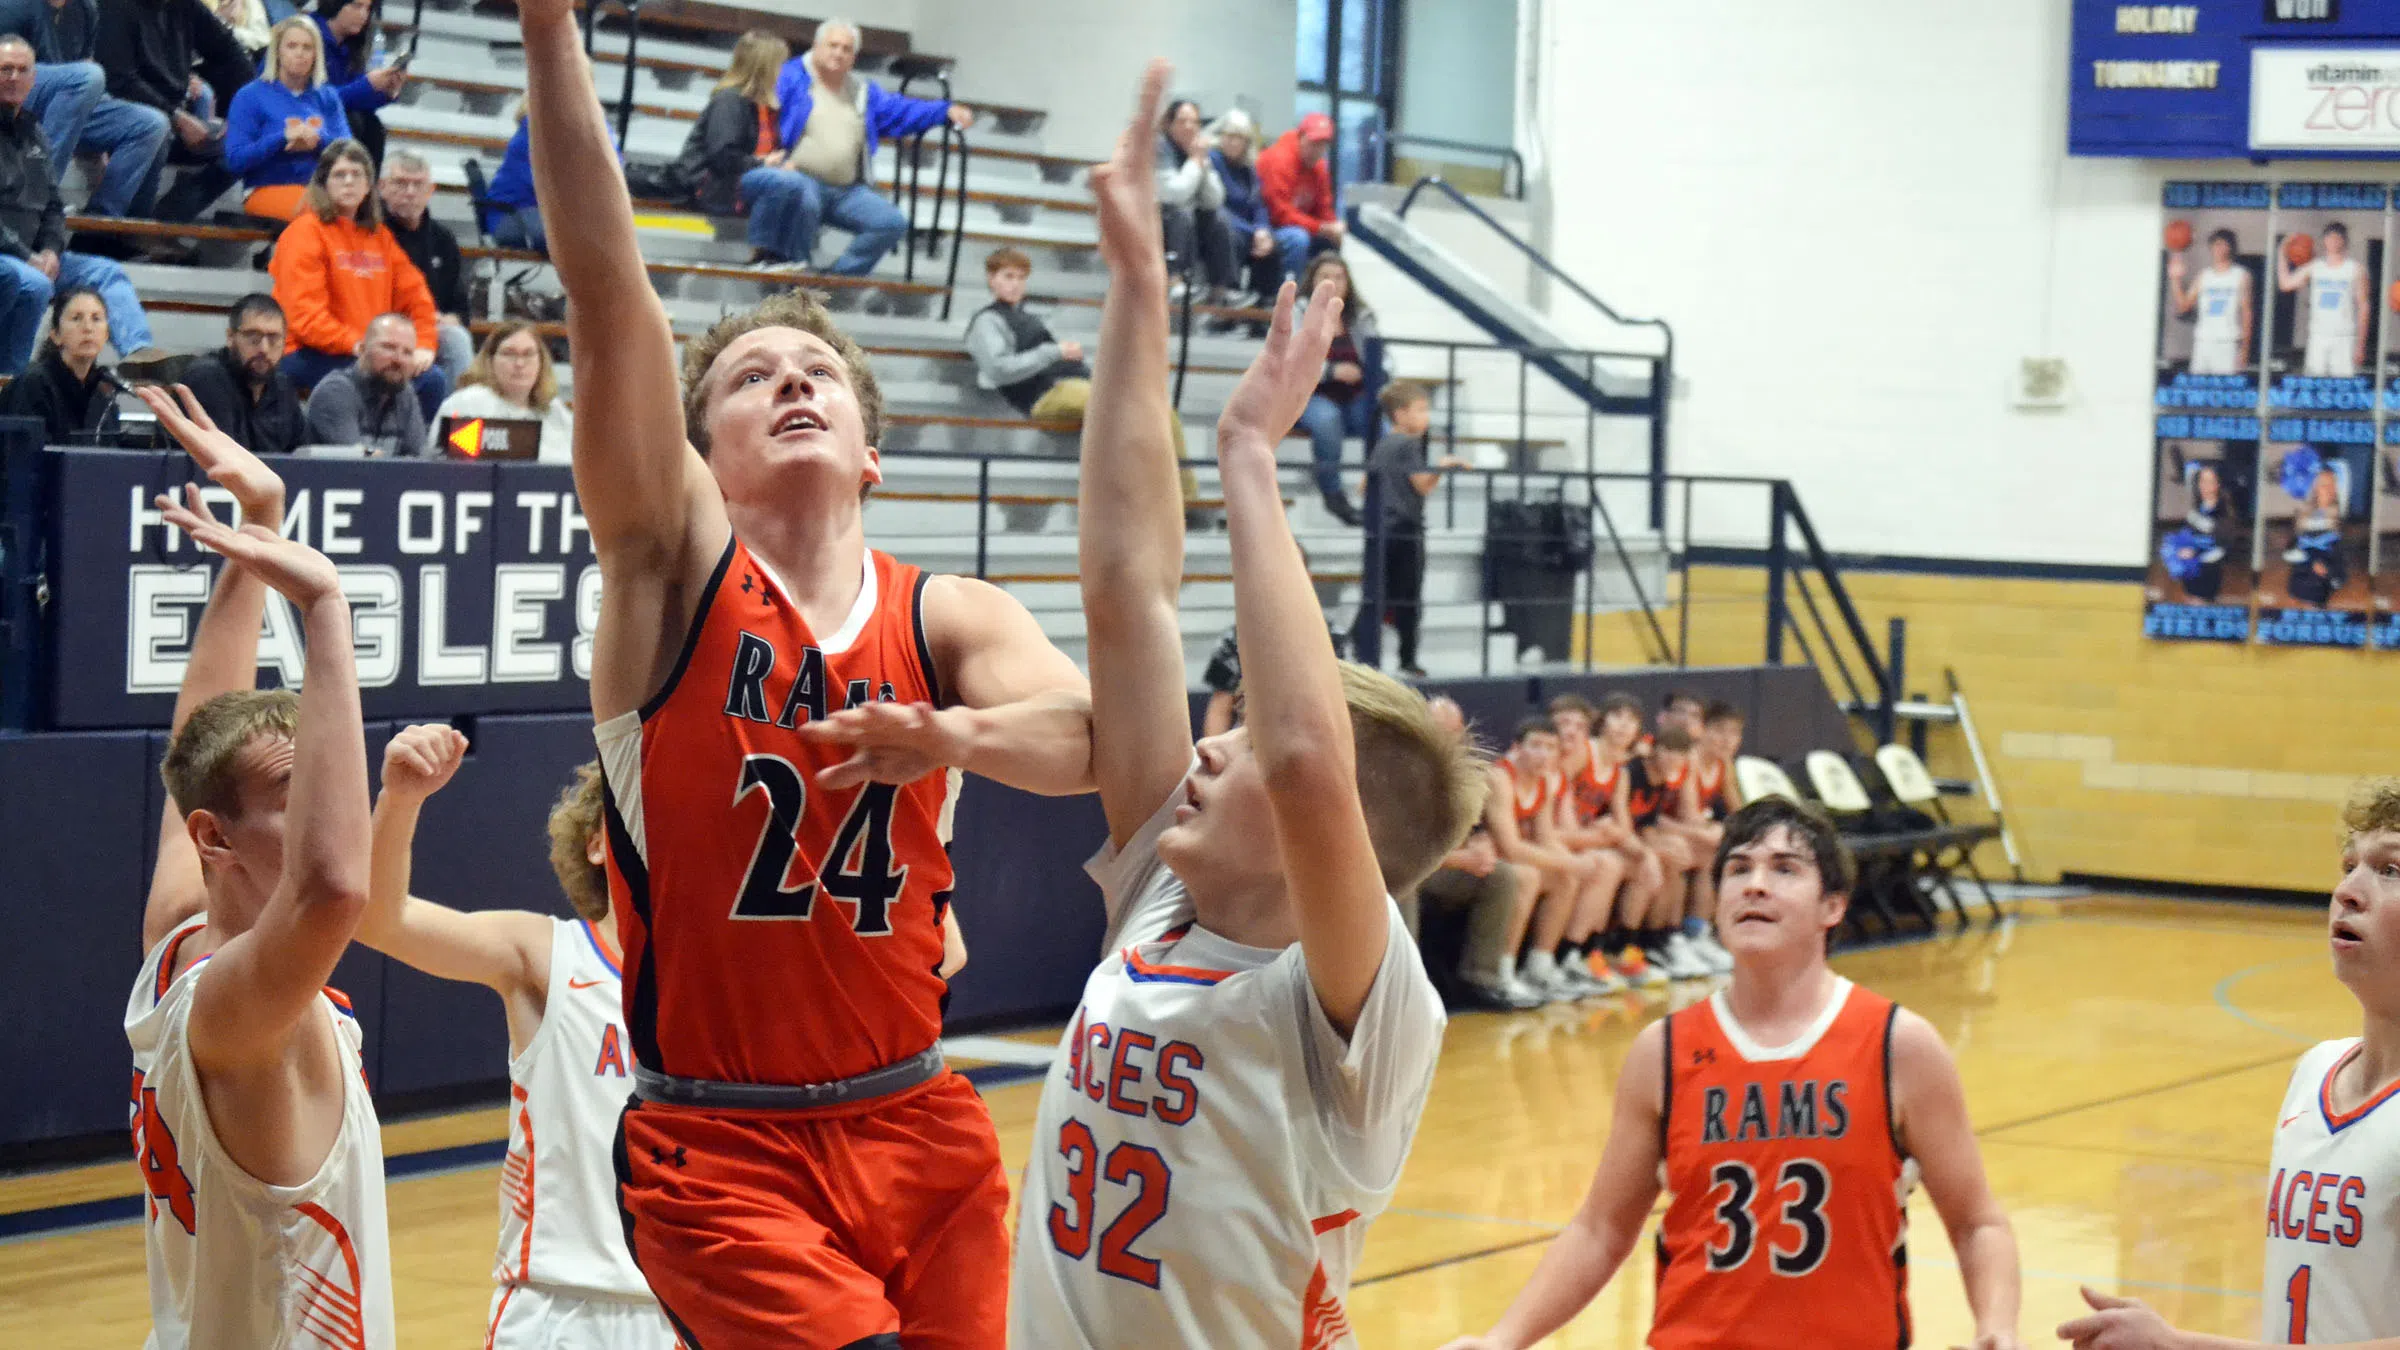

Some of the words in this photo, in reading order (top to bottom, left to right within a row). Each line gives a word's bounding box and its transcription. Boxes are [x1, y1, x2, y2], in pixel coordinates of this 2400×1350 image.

[2115, 6, 2198, 33] HOLIDAY
[2093, 60, 2220, 88] TOURNAMENT
[2266, 388, 2376, 410] MASON
[398, 490, 493, 554] OF
[722, 629, 897, 729] RA
[728, 753, 908, 938] 24
[1065, 1005, 1205, 1127] ACES
[1702, 1079, 1850, 1145] RAMS
[1047, 1115, 1172, 1291] 32
[1704, 1157, 1833, 1281] 33
[2266, 1168, 2367, 1248] ACES
[2286, 1263, 2311, 1345] 1
